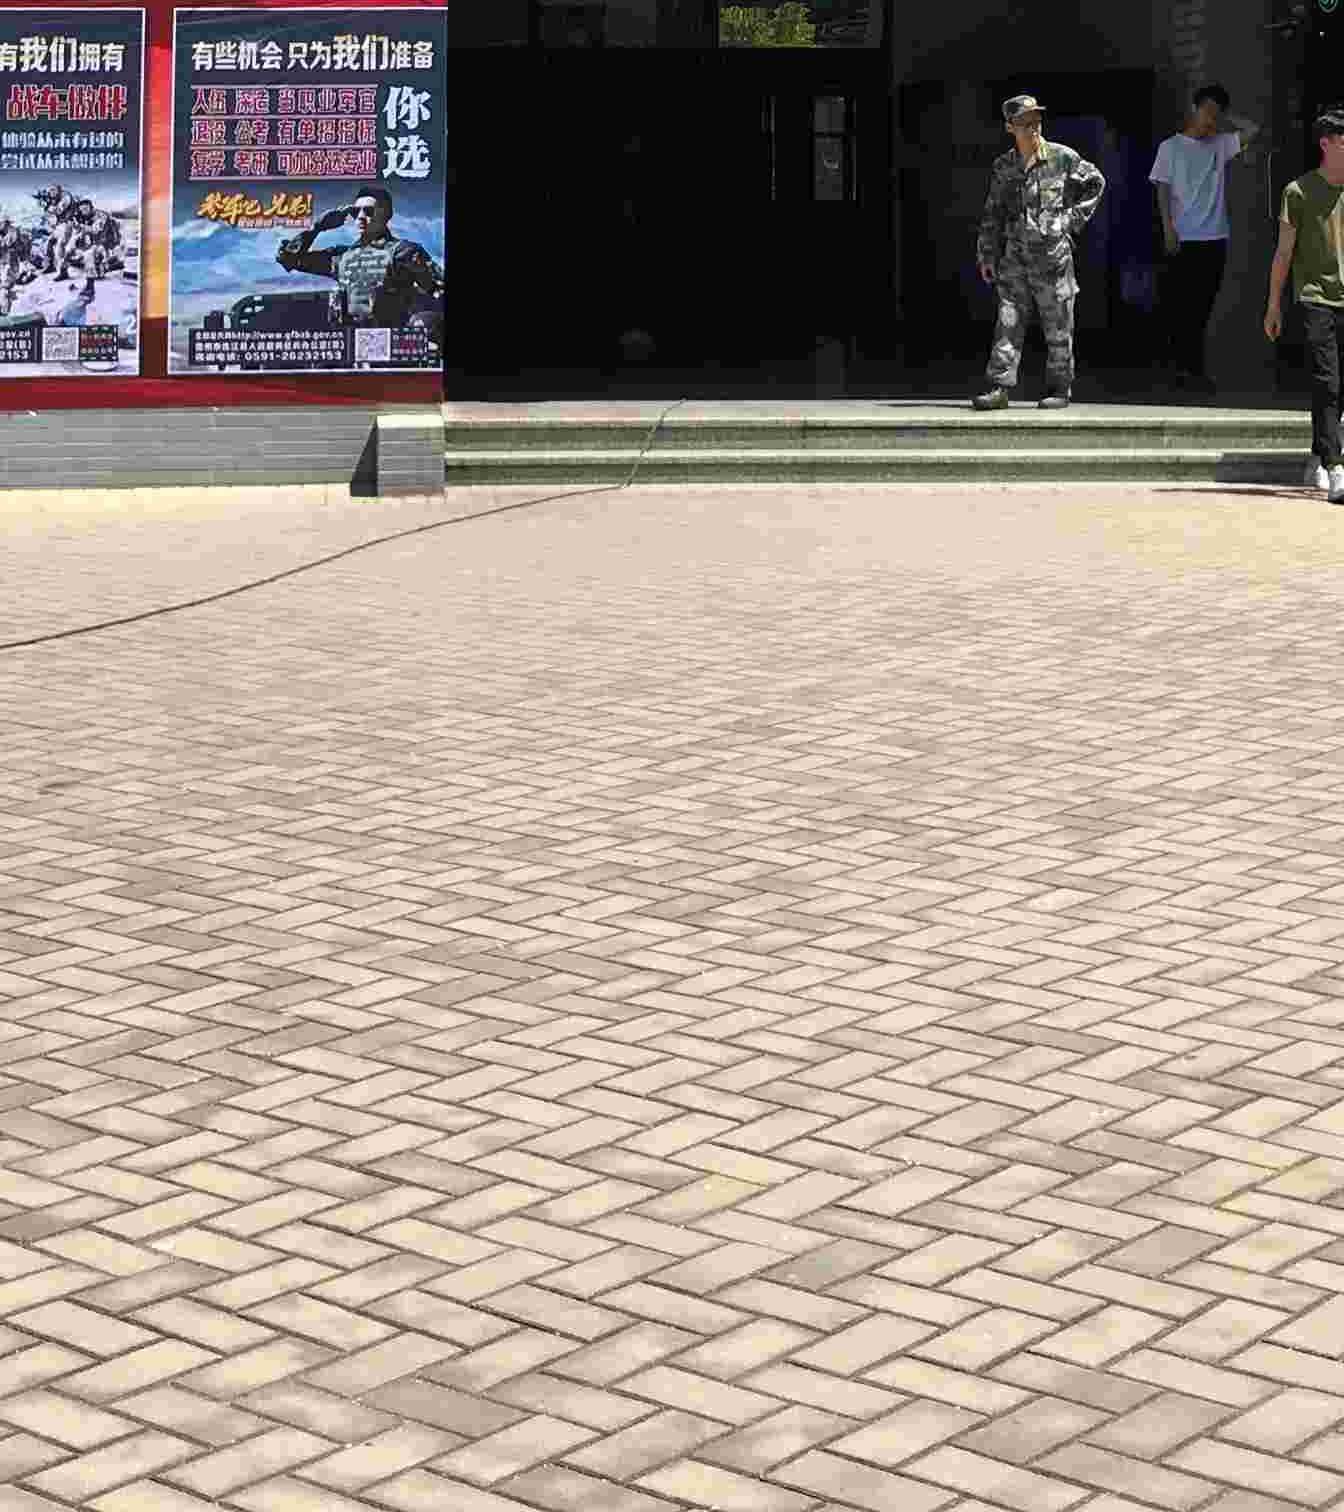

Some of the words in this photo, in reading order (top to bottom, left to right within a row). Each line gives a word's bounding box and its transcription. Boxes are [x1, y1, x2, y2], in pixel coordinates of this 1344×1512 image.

[192, 41, 282, 71] 有些机会
[287, 34, 434, 71] 只为我们准备
[383, 86, 432, 178] 你选
